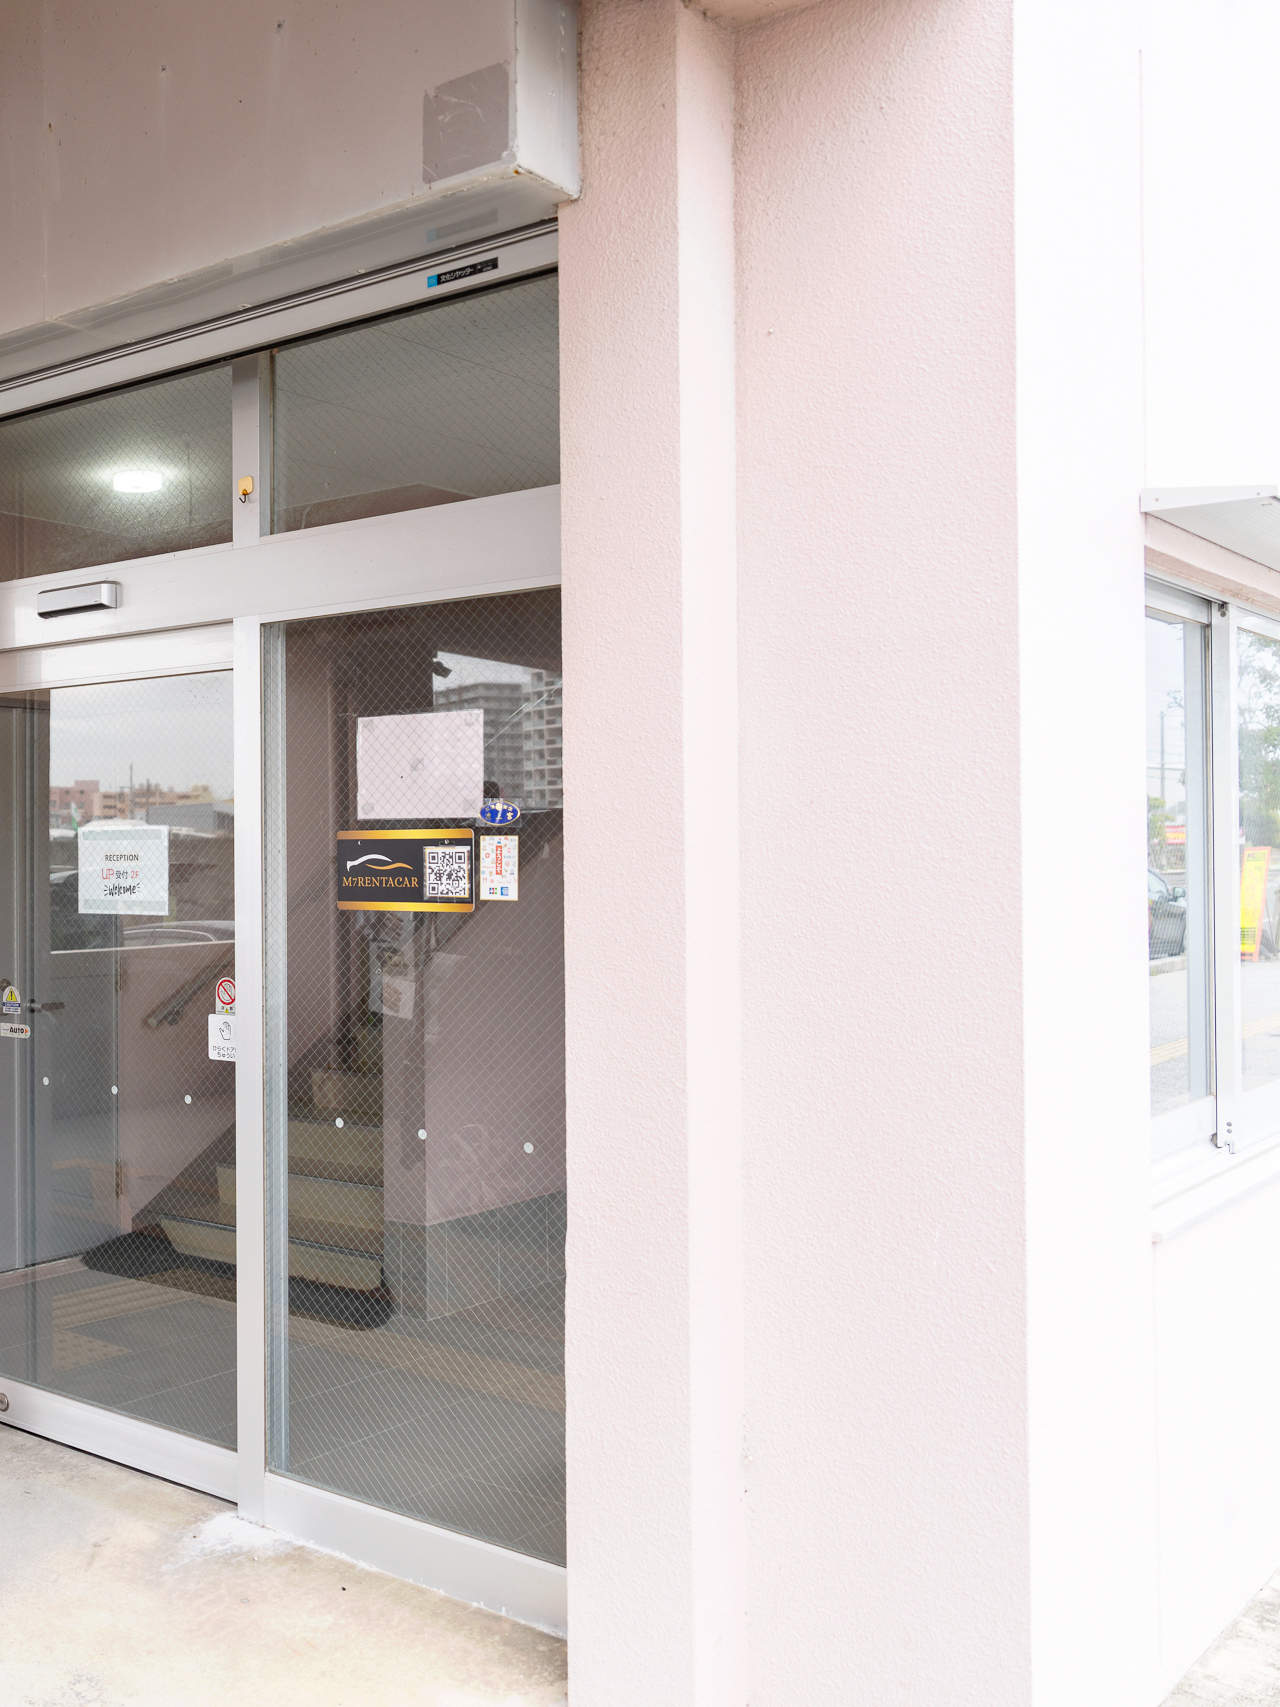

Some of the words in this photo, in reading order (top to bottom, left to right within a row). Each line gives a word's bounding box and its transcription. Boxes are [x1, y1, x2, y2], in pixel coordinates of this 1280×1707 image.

[101, 868, 115, 880] UP
[115, 870, 128, 880] 受付
[130, 870, 139, 879] 2F
[342, 876, 419, 887] M7RENTACAR
